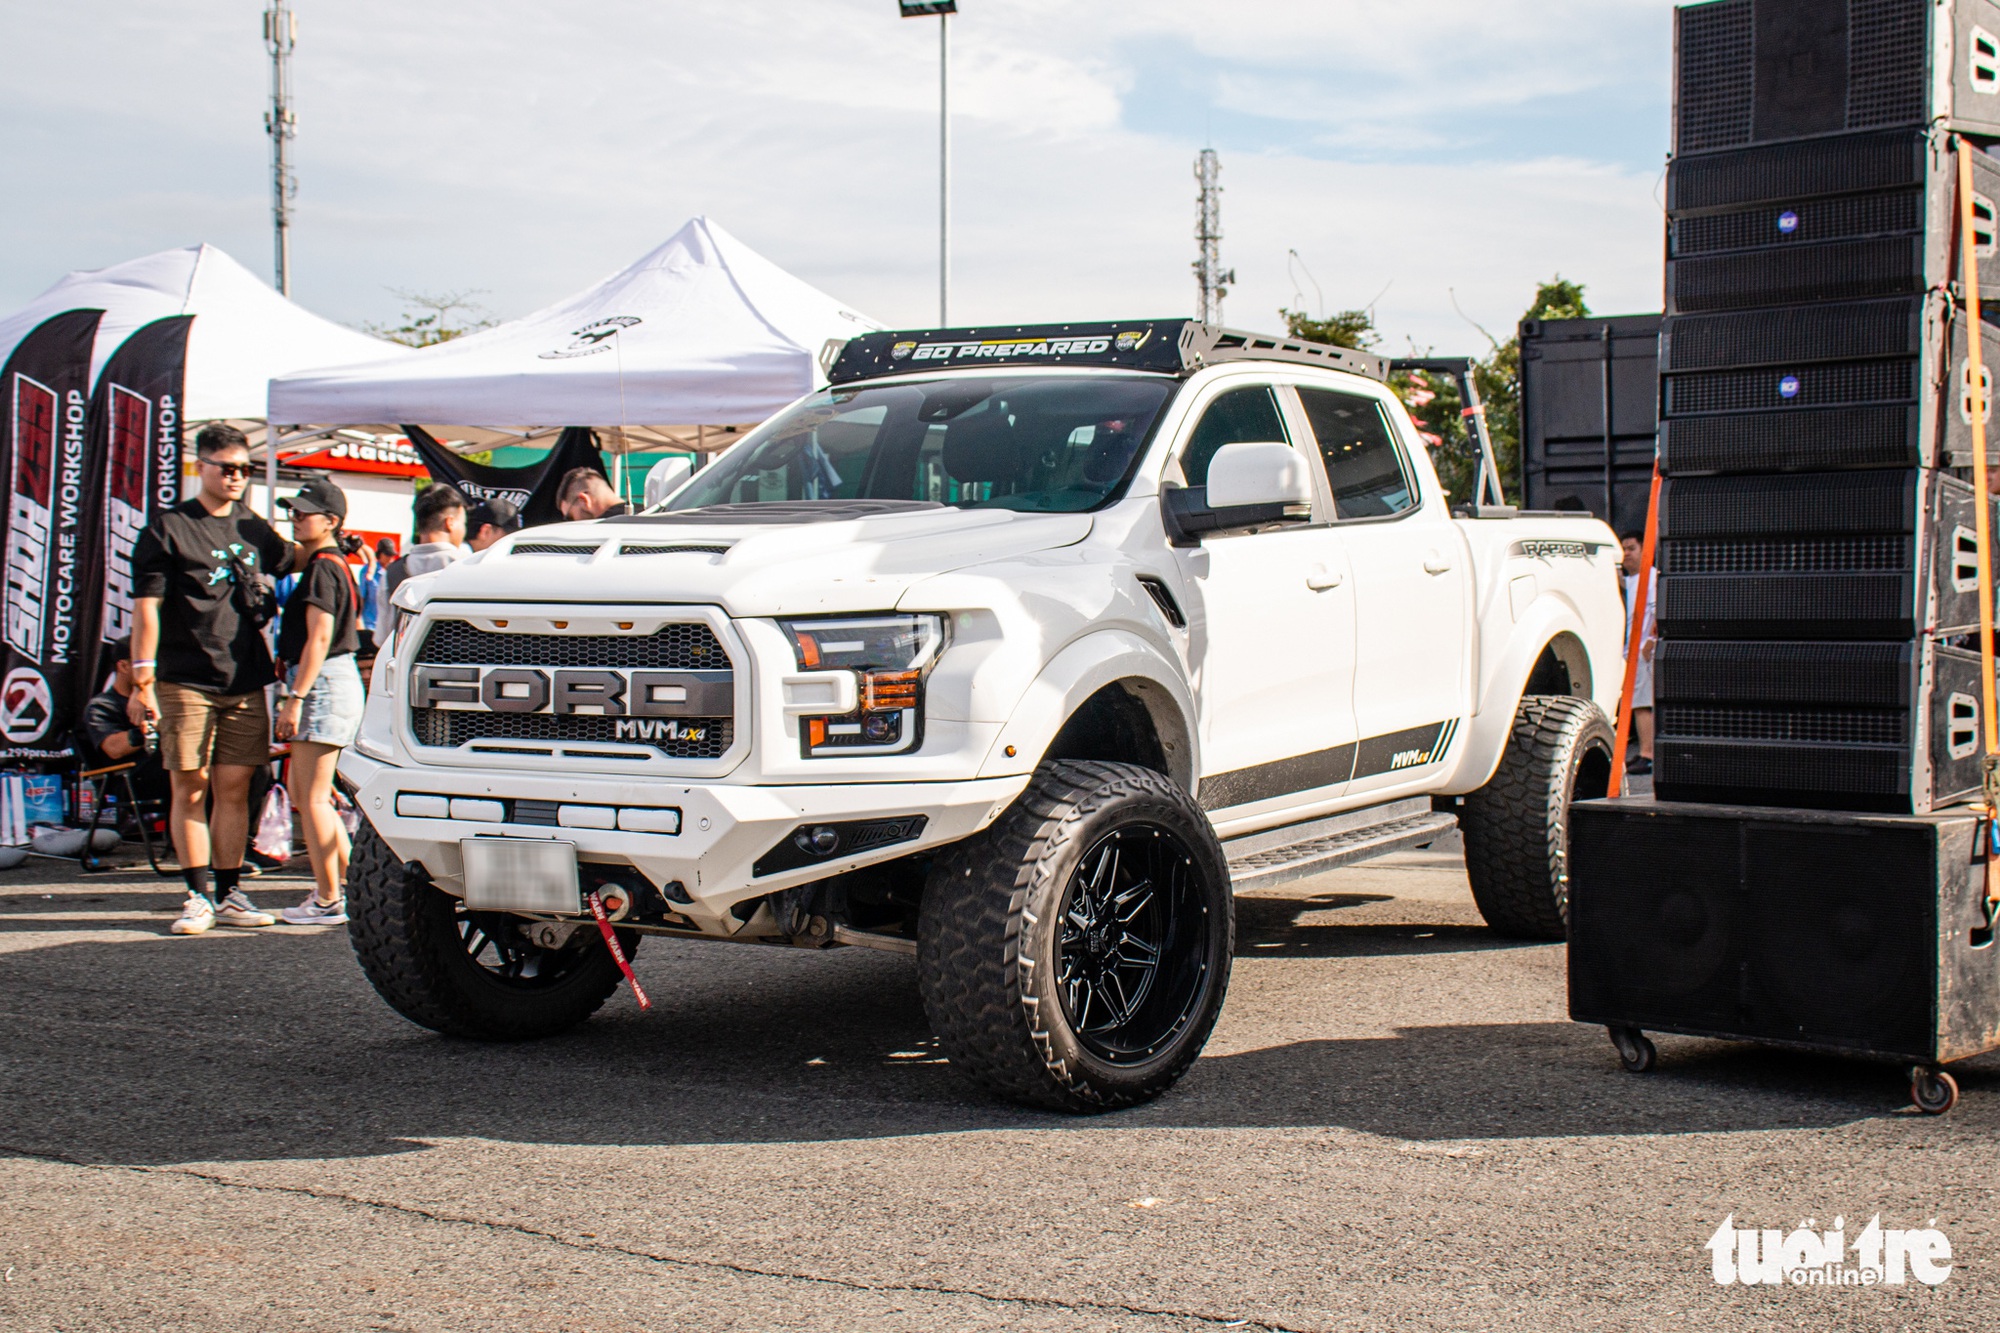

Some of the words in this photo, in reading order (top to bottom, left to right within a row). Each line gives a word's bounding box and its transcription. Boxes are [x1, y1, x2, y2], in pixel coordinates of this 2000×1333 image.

[912, 344, 954, 360] GO
[956, 340, 1110, 358] PREPARED
[15, 377, 55, 510] 299
[60, 389, 84, 528] WORKSHOP
[1521, 541, 1590, 562] RAPTOR
[8, 492, 52, 659] SHOP
[51, 533, 76, 664] MOTOCARE
[411, 667, 710, 716] FORD
[615, 720, 678, 740] MVM
[590, 891, 605, 920] WARN
[608, 935, 625, 963] WARN
[632, 978, 648, 1006] WARN
